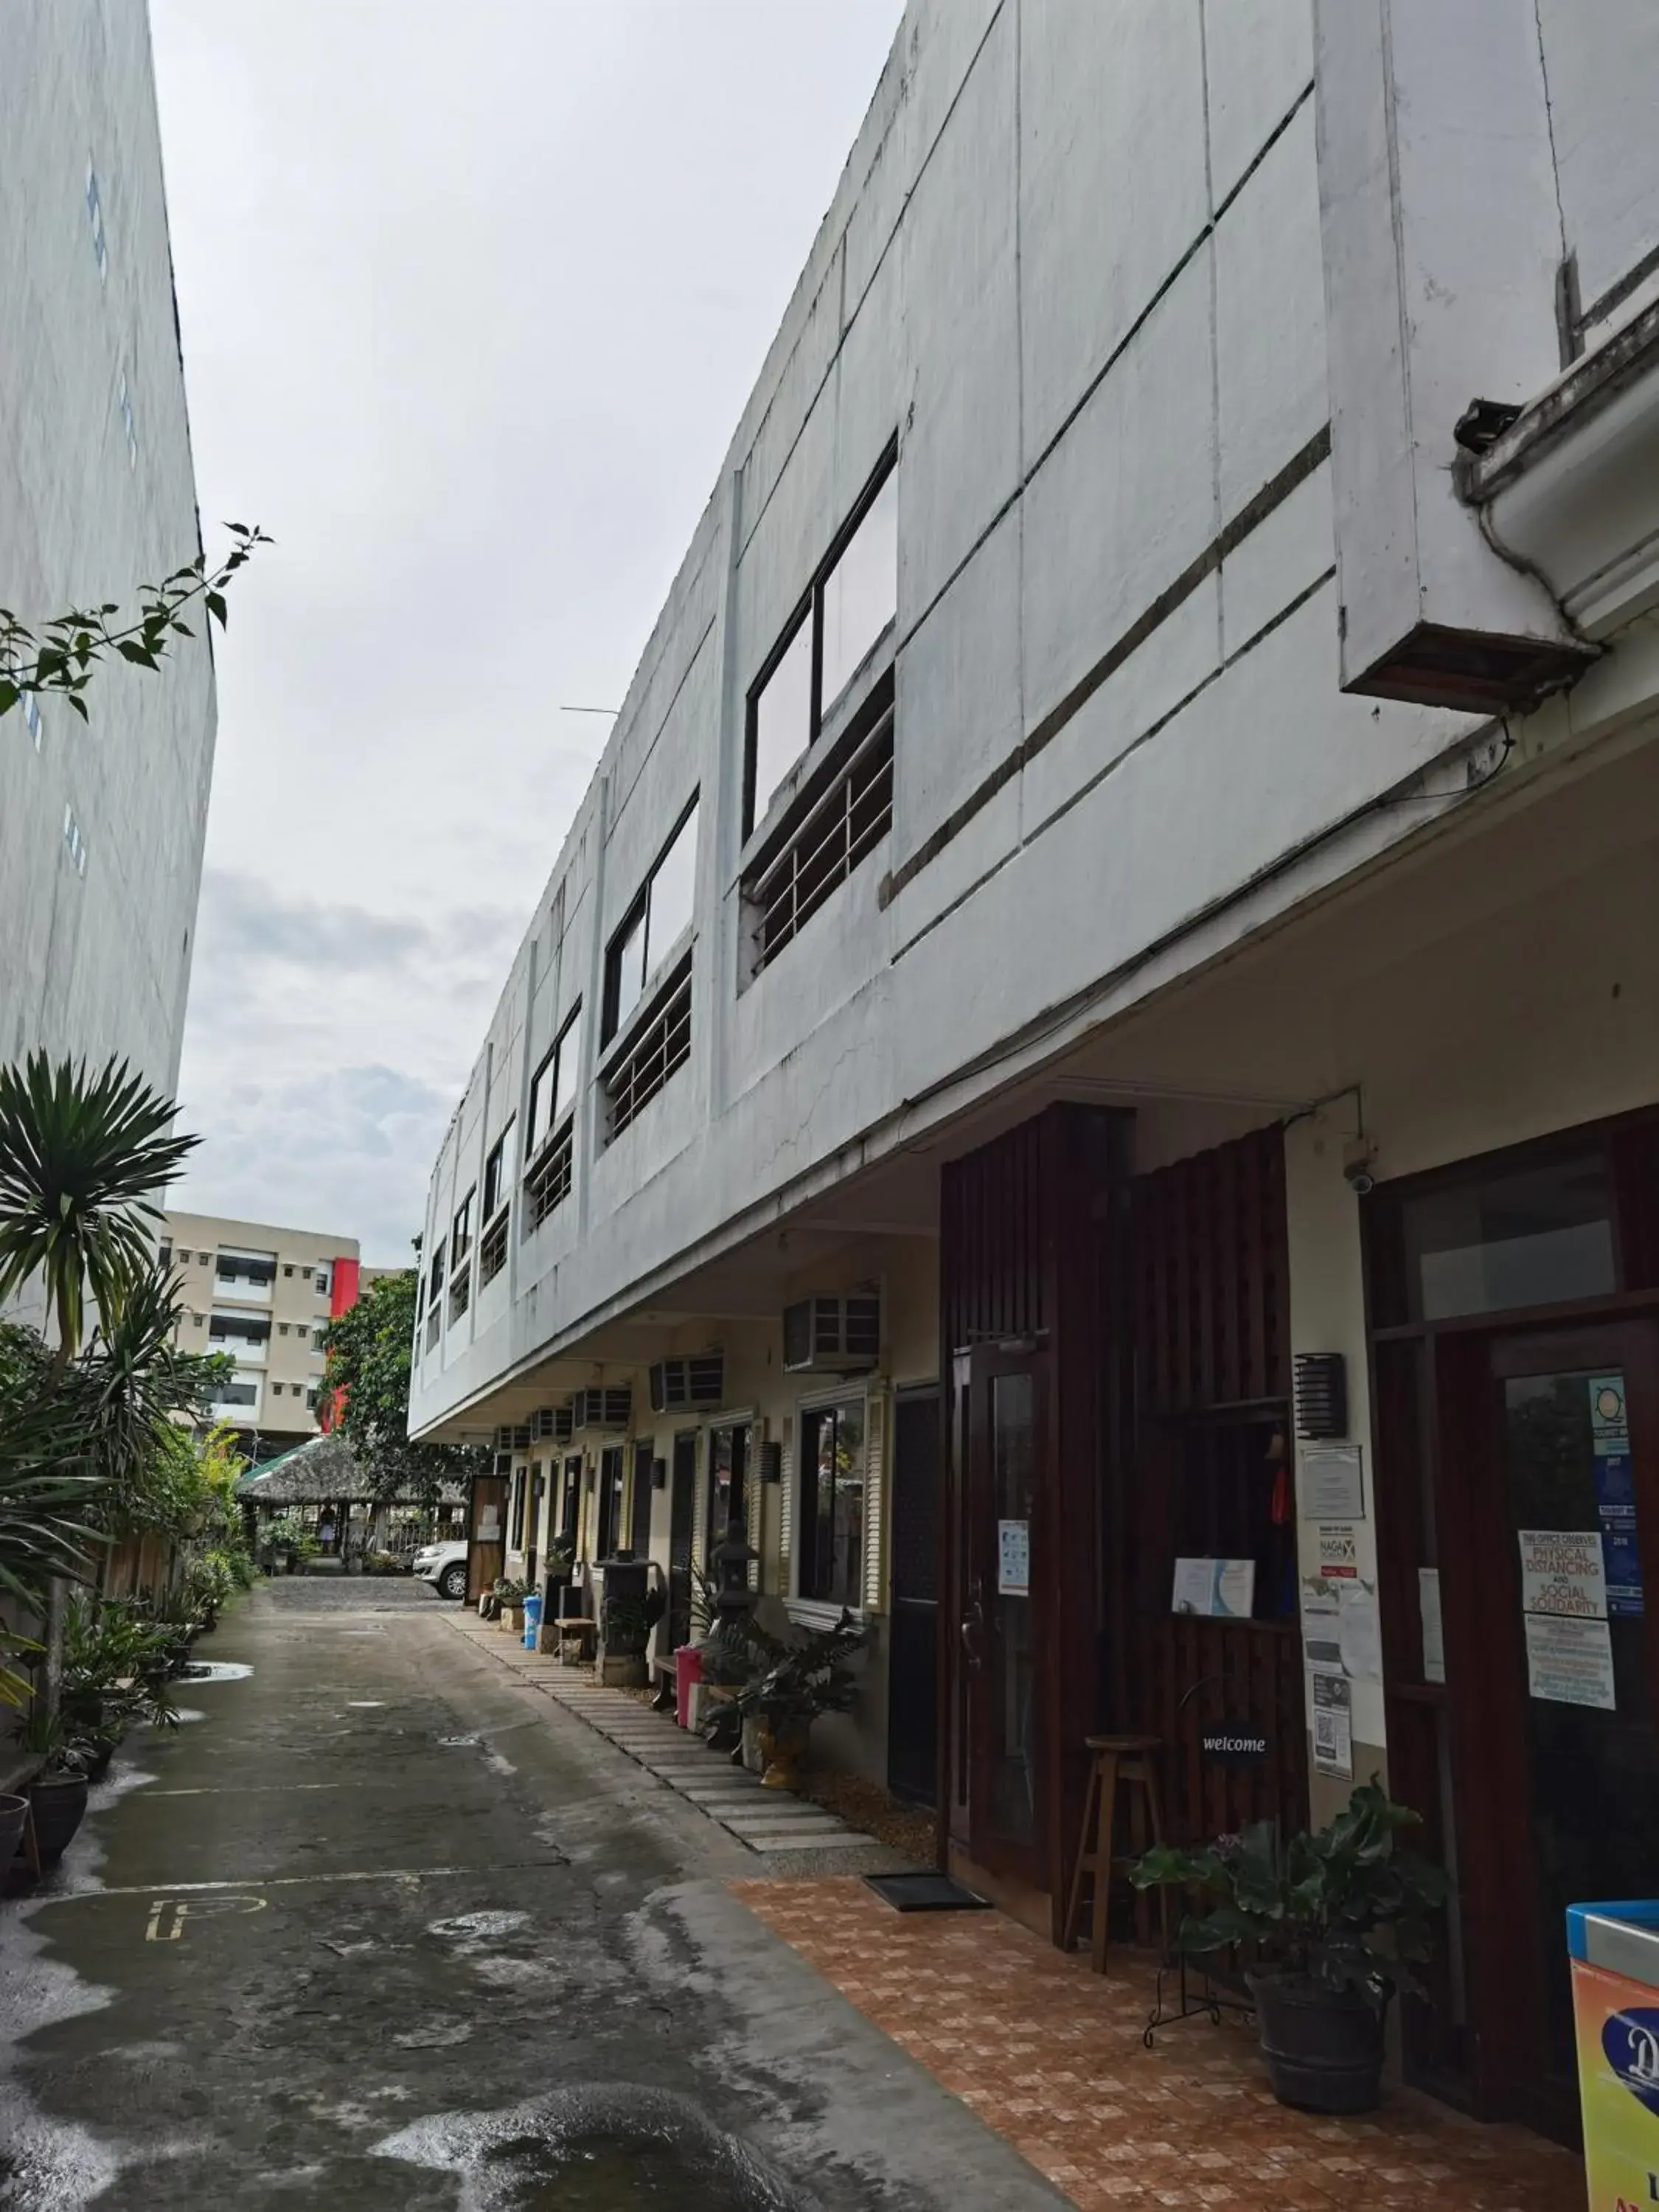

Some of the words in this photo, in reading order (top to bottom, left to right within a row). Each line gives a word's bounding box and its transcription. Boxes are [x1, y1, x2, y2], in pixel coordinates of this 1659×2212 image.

[1533, 1546, 1588, 1562] PHYSICAL
[1526, 1559, 1599, 1576] DISTANCING
[1540, 1584, 1587, 1600] SOCIAL
[1531, 1597, 1599, 1615] SOLIDARITY
[1203, 1736, 1267, 1753] welcome
